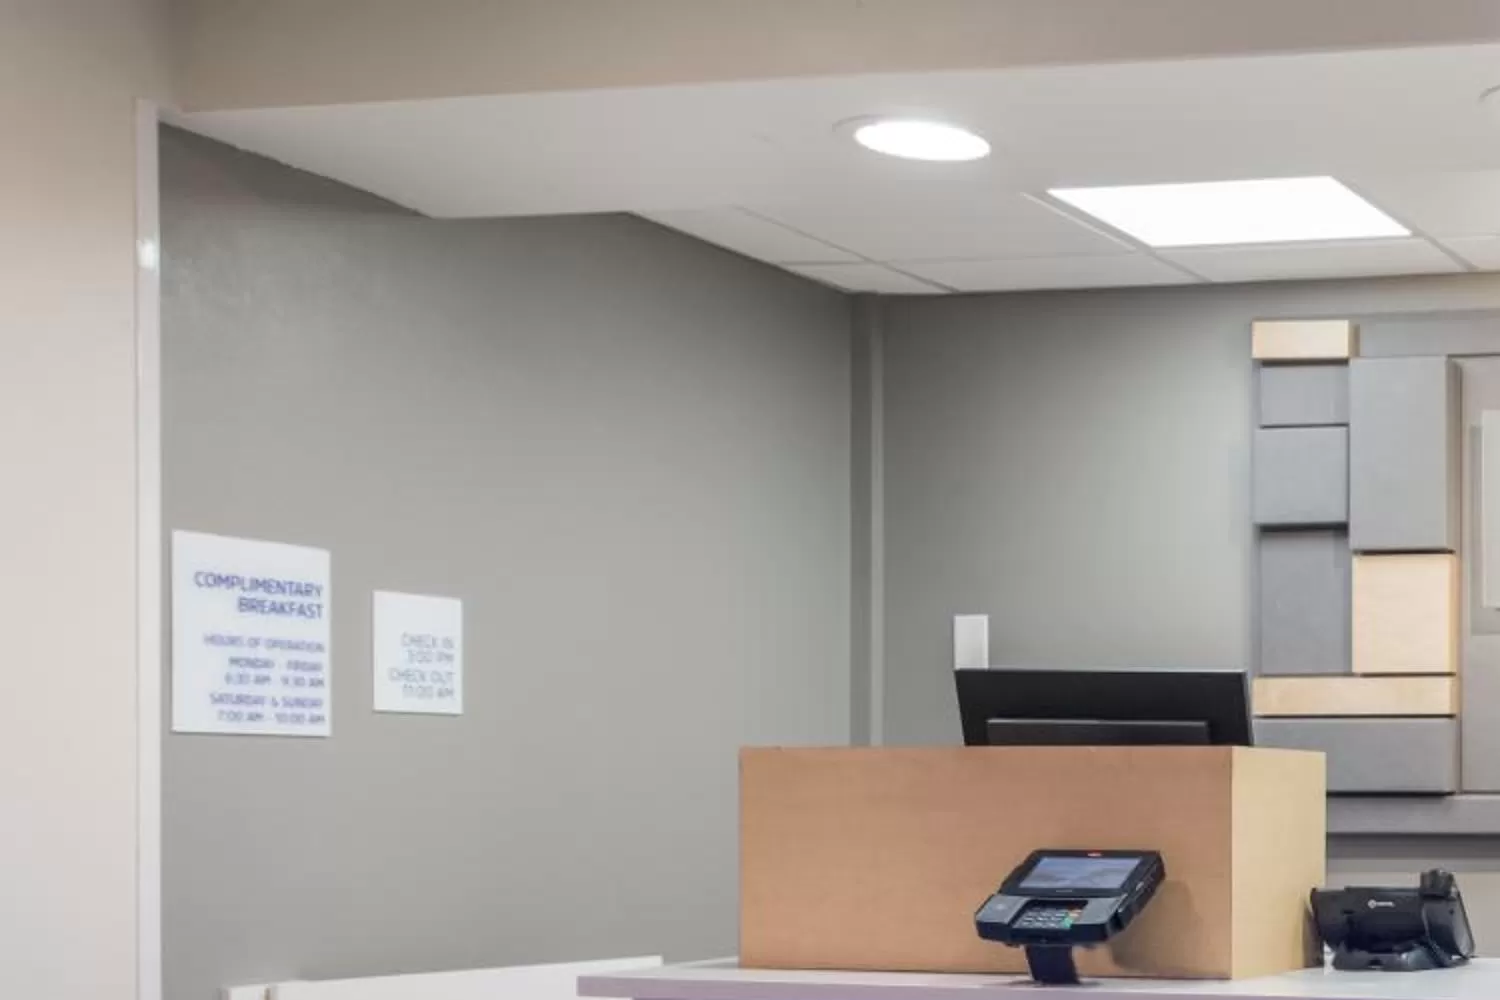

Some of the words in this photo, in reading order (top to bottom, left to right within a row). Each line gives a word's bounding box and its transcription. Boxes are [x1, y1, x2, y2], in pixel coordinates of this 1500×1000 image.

[194, 571, 324, 597] COMPLIMENTARY
[237, 596, 324, 619] BREAKFAST
[203, 633, 244, 647] HOURS
[247, 636, 262, 649] OF
[264, 638, 325, 653] OPERATION
[400, 631, 437, 649] CHECK
[228, 656, 276, 669] MONDAY
[286, 660, 324, 672] FRIDAY
[436, 651, 455, 664] PM
[253, 674, 272, 686] AM
[308, 677, 325, 688] AM
[387, 667, 426, 682] CHECK
[429, 669, 456, 685] OUT
[209, 692, 266, 705] SATURDAY
[281, 695, 324, 708] SUNDAY
[436, 686, 455, 699] AM
[246, 711, 265, 723] AM
[308, 714, 325, 725] AM
